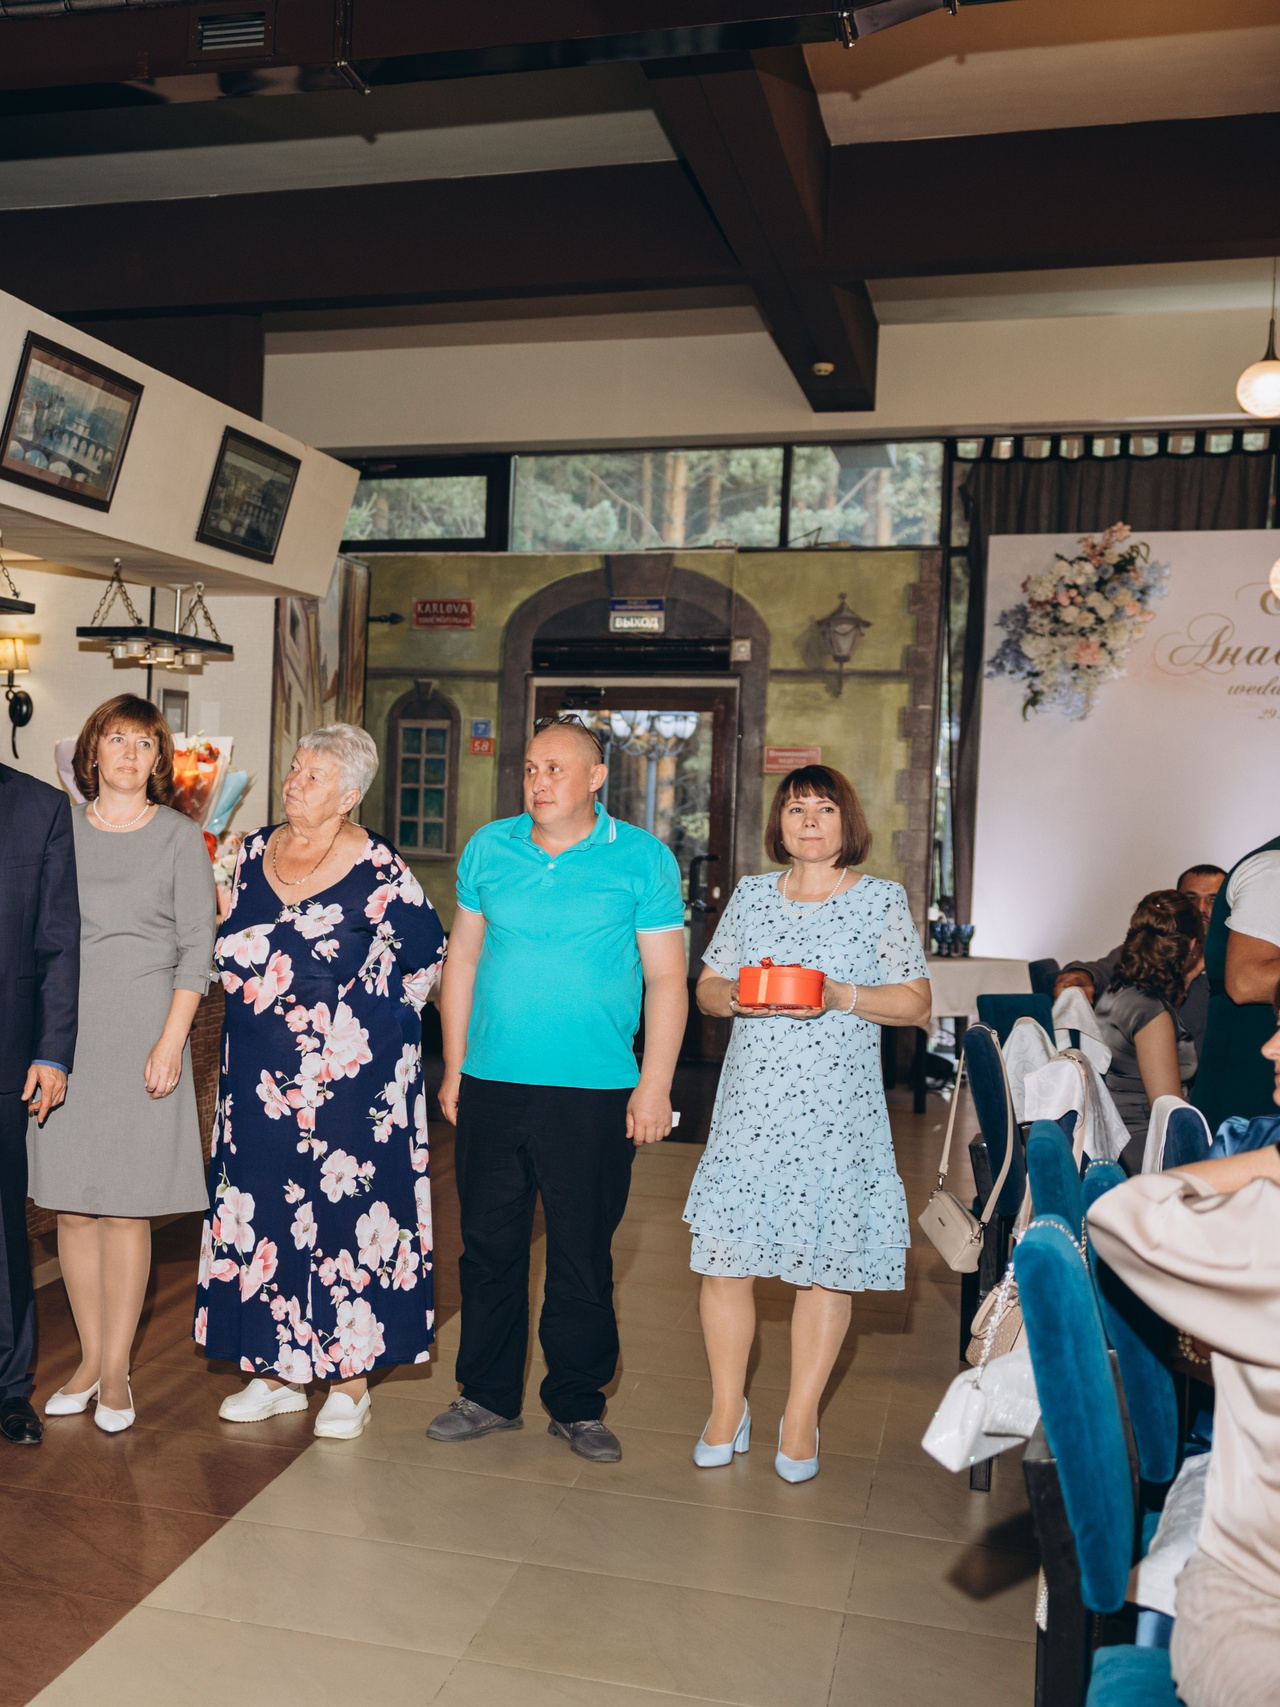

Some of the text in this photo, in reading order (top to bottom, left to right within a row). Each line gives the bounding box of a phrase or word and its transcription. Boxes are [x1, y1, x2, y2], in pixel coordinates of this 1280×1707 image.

[417, 603, 468, 614] KARLOVA
[615, 617, 659, 629] ВЫХОД
[1257, 708, 1280, 720] 29
[474, 740, 490, 751] 58
